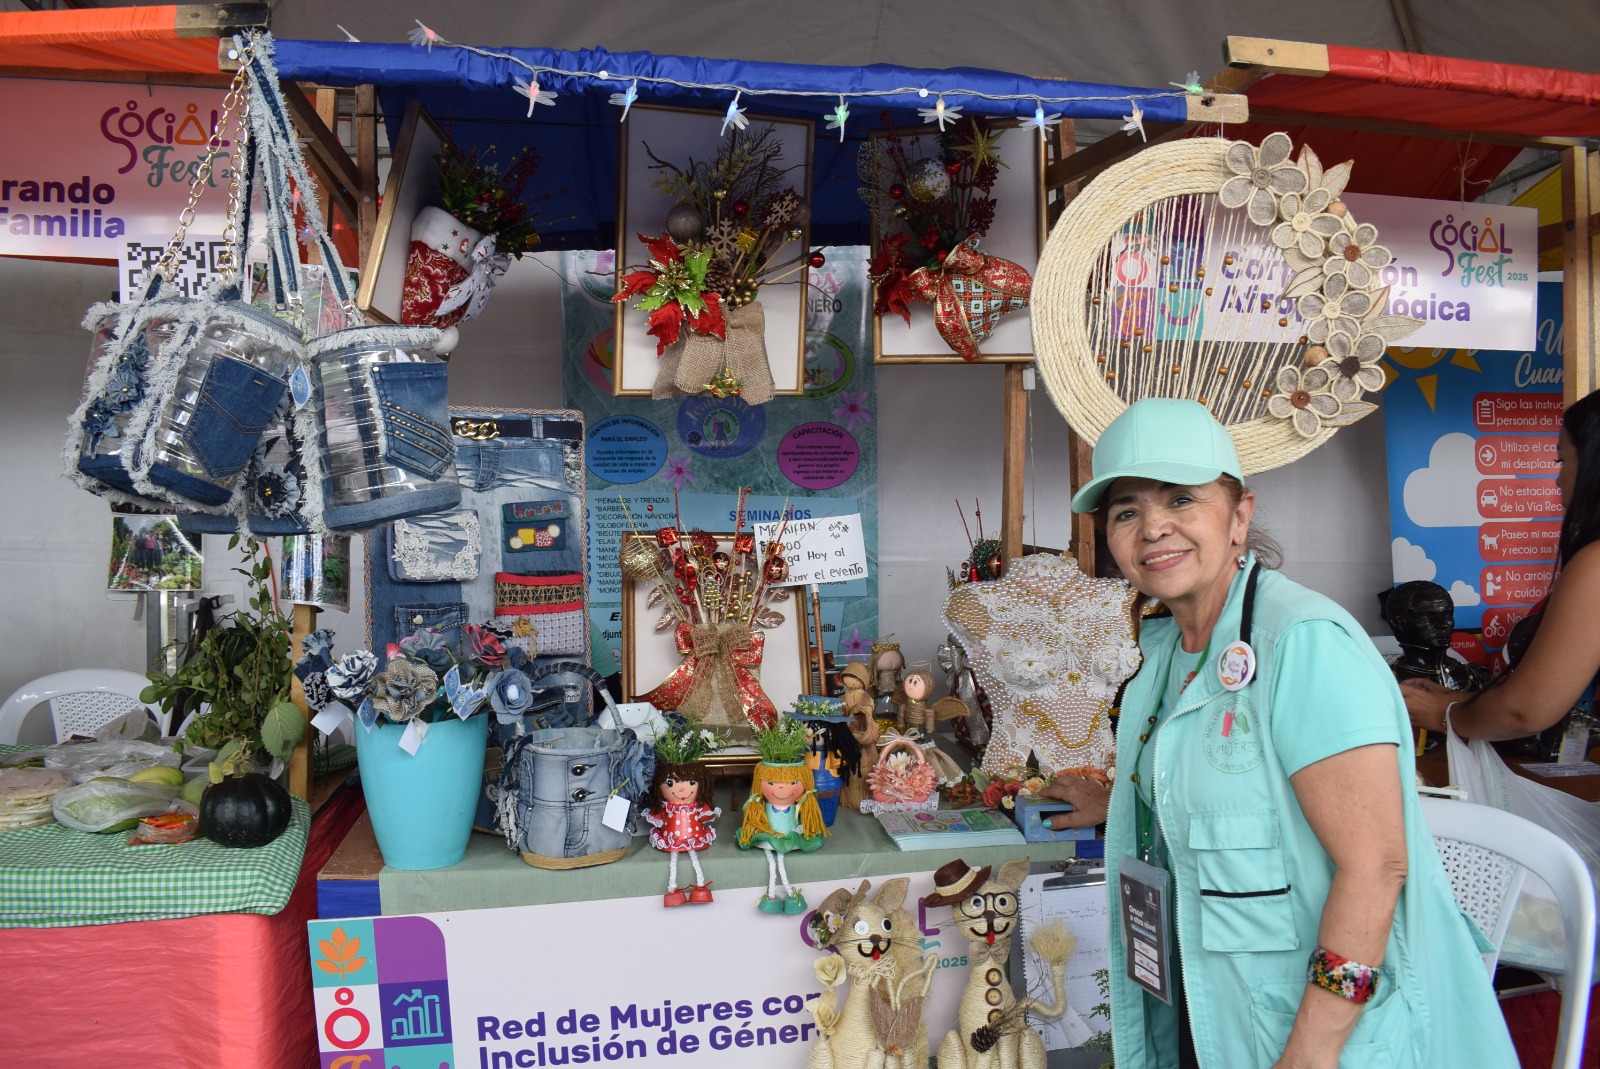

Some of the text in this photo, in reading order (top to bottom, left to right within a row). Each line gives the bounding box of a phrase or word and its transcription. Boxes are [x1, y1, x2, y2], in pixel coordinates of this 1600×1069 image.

[142, 145, 230, 188] Fest
[1457, 252, 1529, 288] Fest 2025
[1496, 399, 1518, 411] Sigo
[1519, 399, 1533, 409] las
[1496, 415, 1537, 427] personal
[1539, 416, 1553, 426] de
[1500, 442, 1530, 452] Utilizo
[1532, 442, 1541, 452] el
[1501, 460, 1511, 469] mi
[1499, 486, 1514, 496] No
[1500, 502, 1513, 512] de
[1515, 502, 1525, 512] la
[1501, 530, 1529, 540] Paseo
[1530, 530, 1540, 539] mi
[807, 551, 827, 562] Hoy
[1502, 548, 1507, 557] y
[1509, 545, 1538, 555] recojo
[1540, 545, 1552, 554] sus
[814, 569, 825, 580] el
[1505, 571, 1521, 581] No
[1506, 591, 1512, 600] y
[1514, 588, 1542, 598] cuido
[810, 624, 836, 633] cstilla
[935, 956, 969, 970] 2025
[477, 1012, 547, 1042] Red
[556, 1009, 600, 1036] de
[610, 999, 754, 1033] Mujeres
[479, 1021, 824, 1069] Inclusión de Géner
